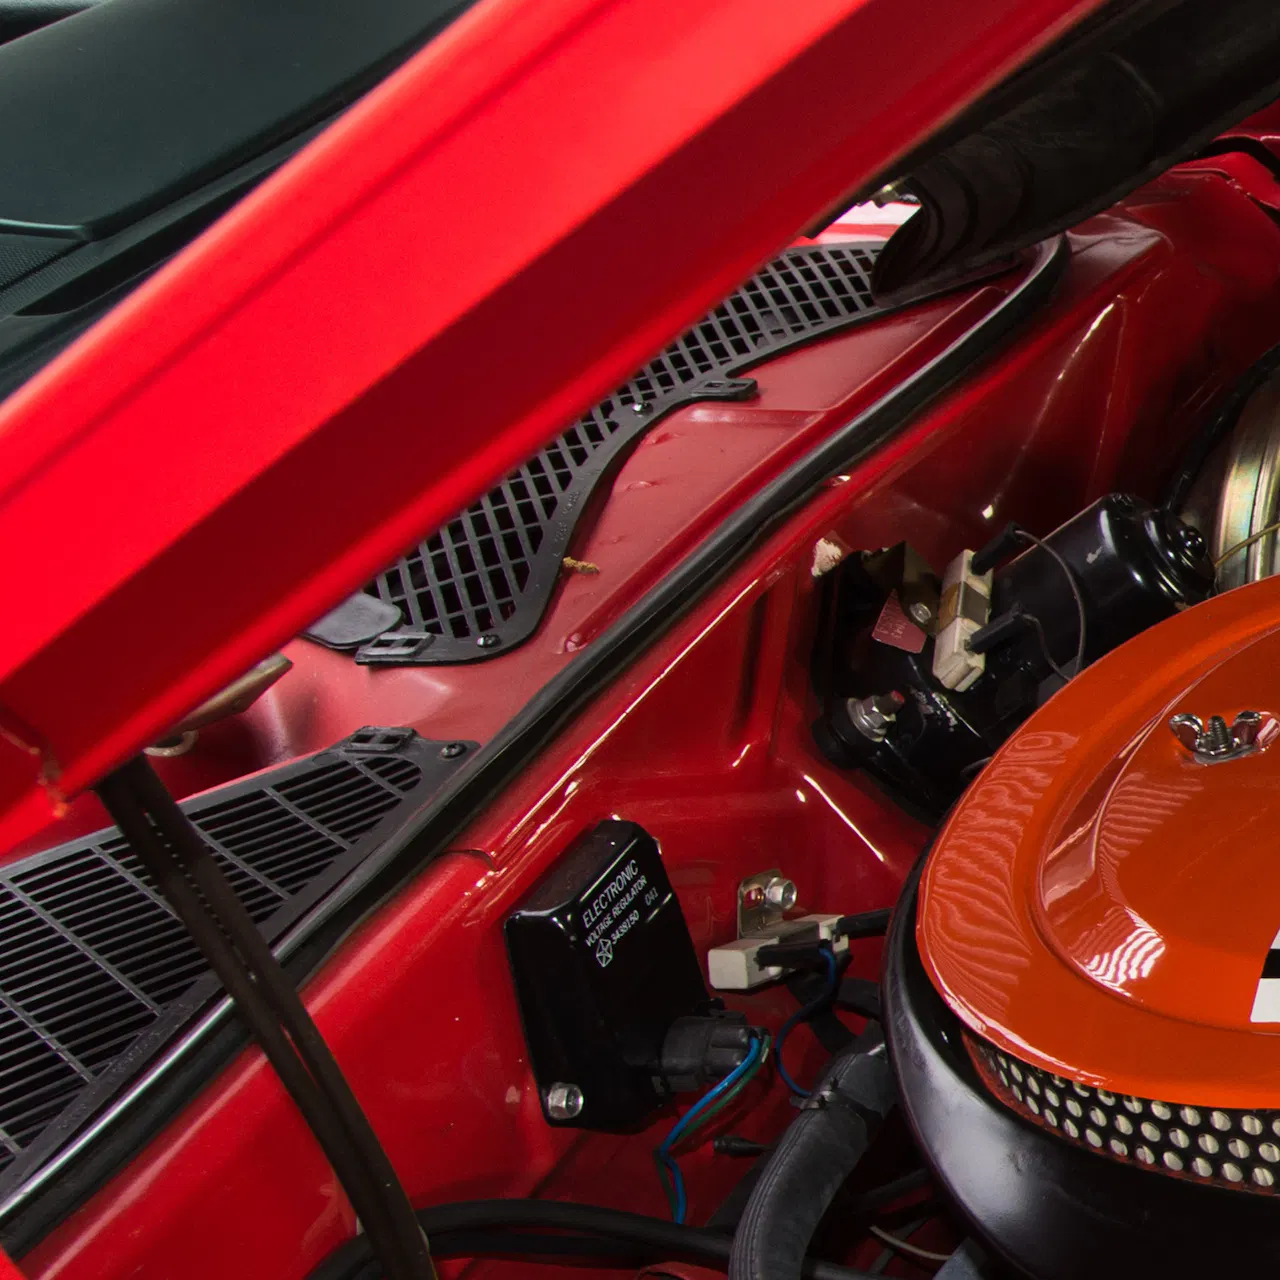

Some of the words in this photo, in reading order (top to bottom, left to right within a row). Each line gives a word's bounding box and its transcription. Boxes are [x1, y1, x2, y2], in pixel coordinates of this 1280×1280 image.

[582, 859, 638, 928] ELECTRONIC
[585, 912, 613, 946] VOLTAGE
[612, 875, 647, 918] REGULATOR
